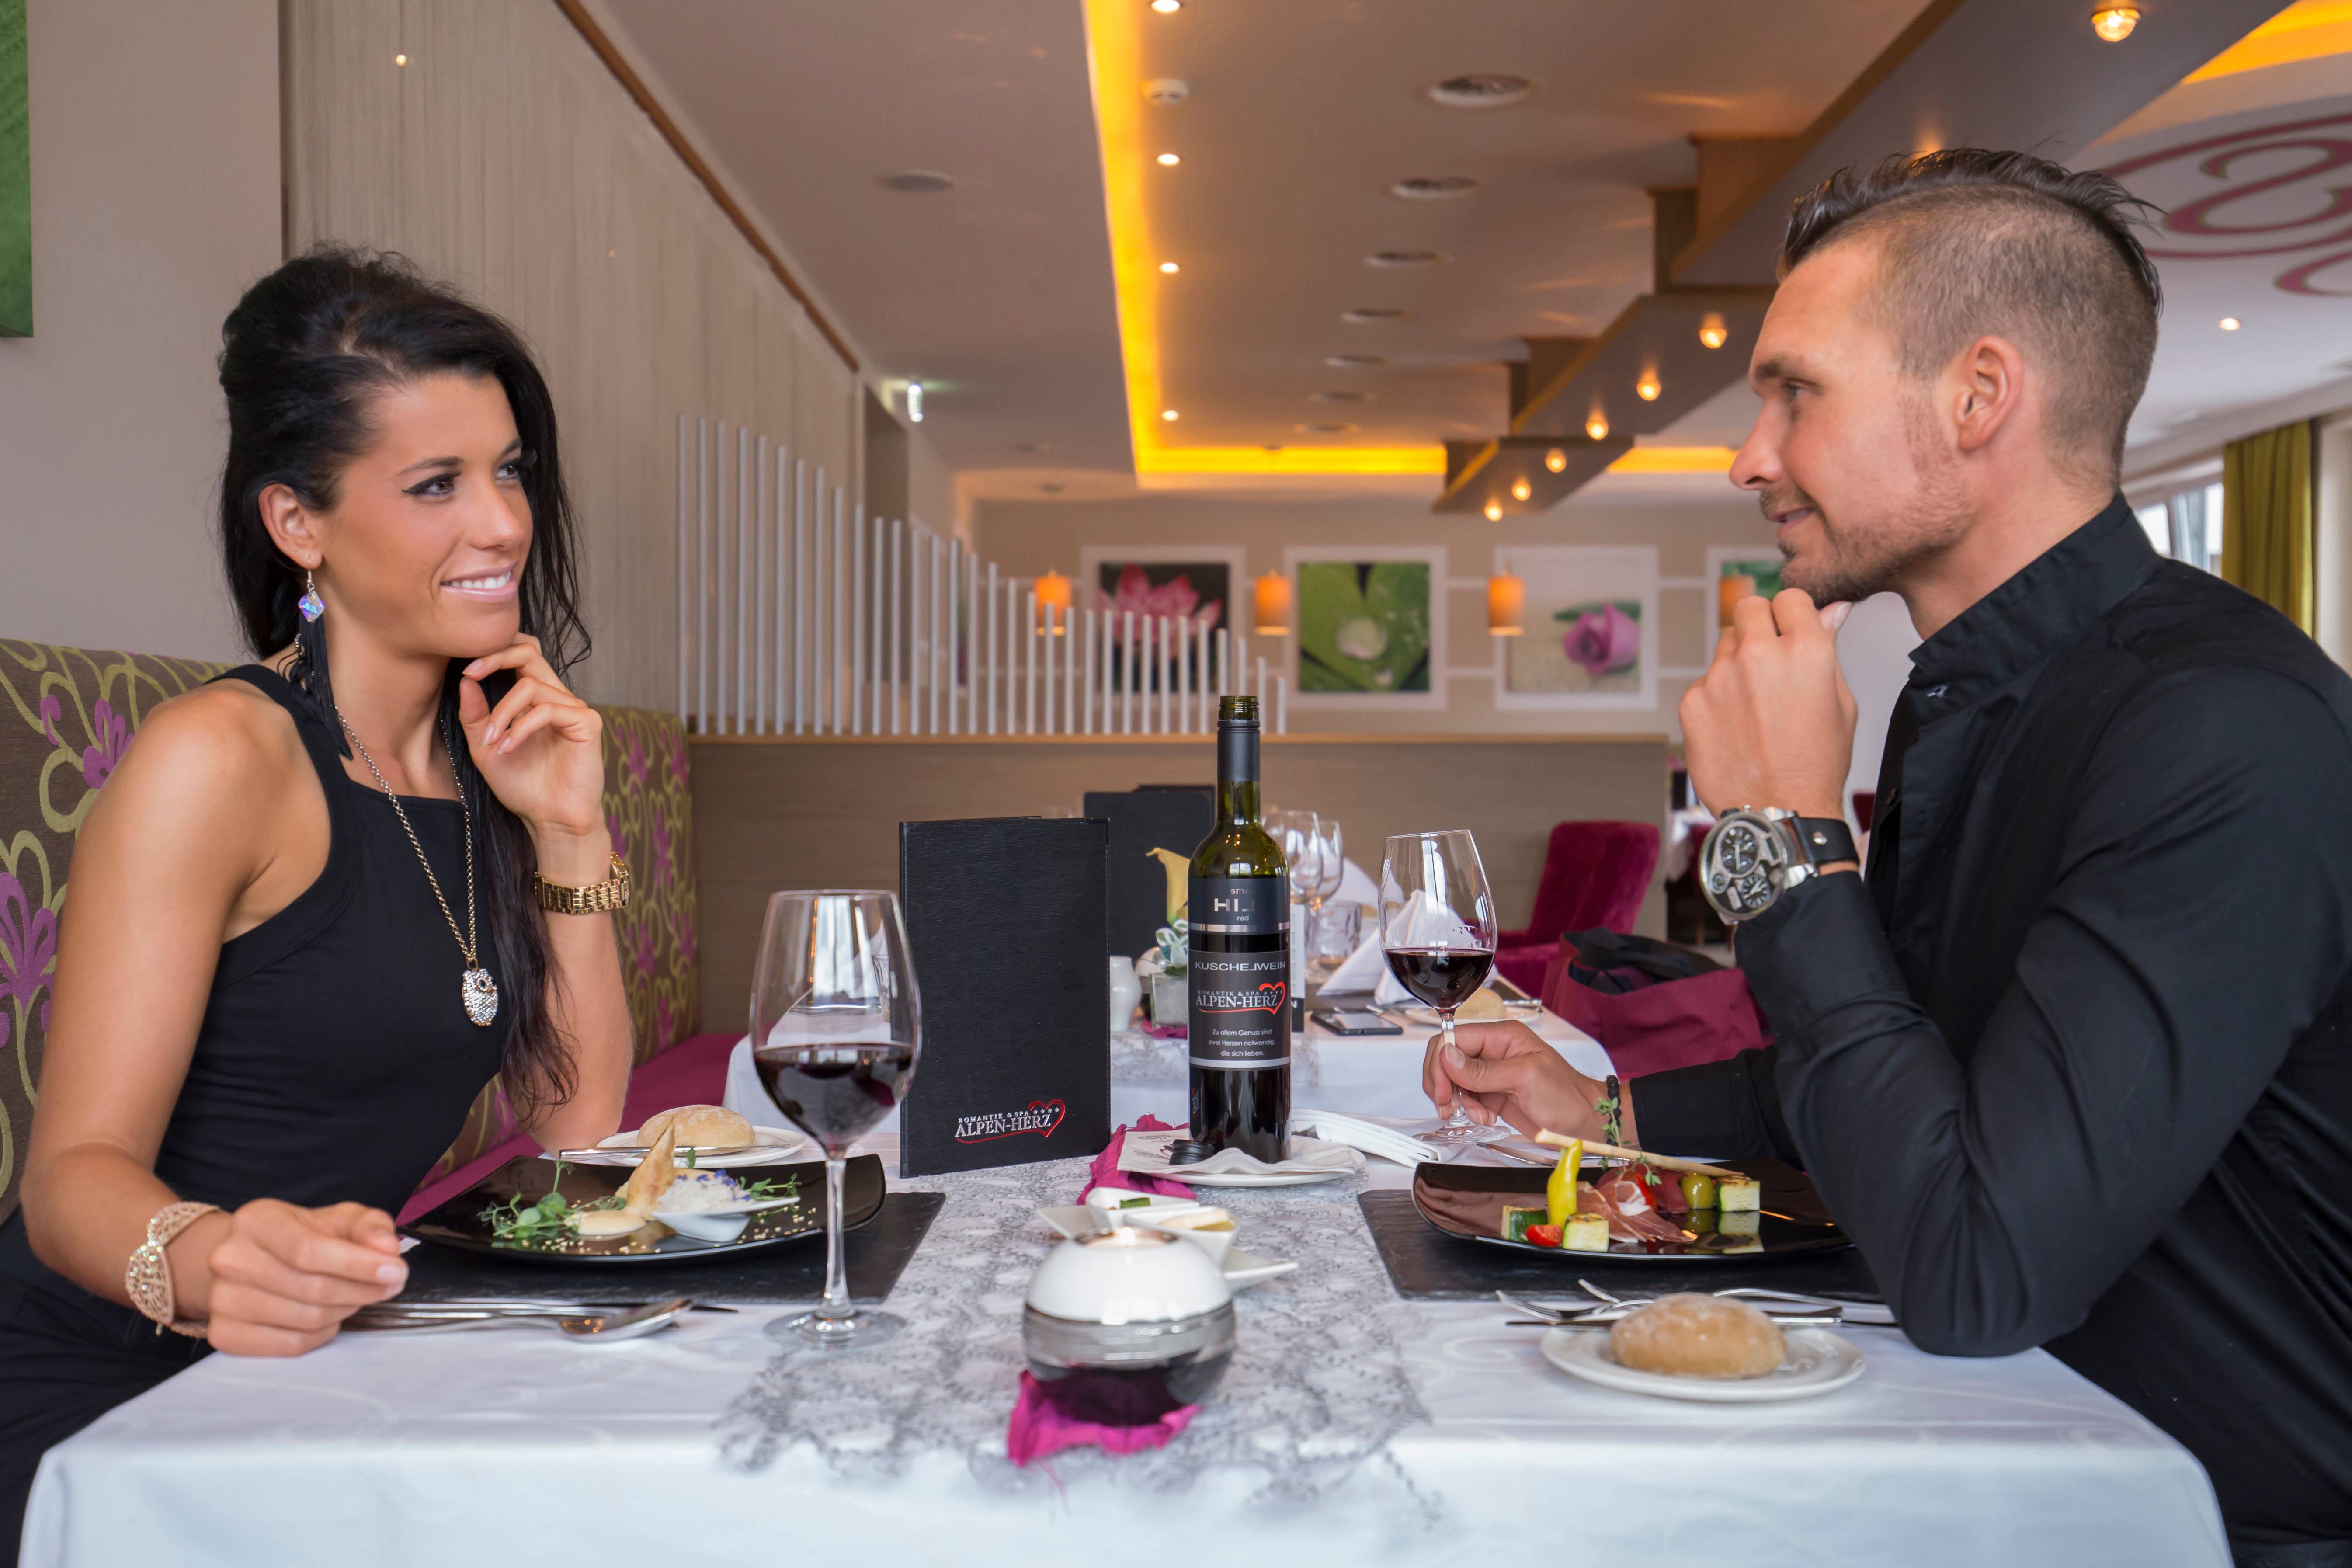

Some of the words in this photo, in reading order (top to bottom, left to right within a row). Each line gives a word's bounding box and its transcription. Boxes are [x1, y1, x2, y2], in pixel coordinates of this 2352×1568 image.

[1195, 994, 1278, 1008] ALPEN-HERZ
[958, 1113, 1003, 1123] ROMANTIK
[955, 1114, 1051, 1137] ALPEN-HERZ
